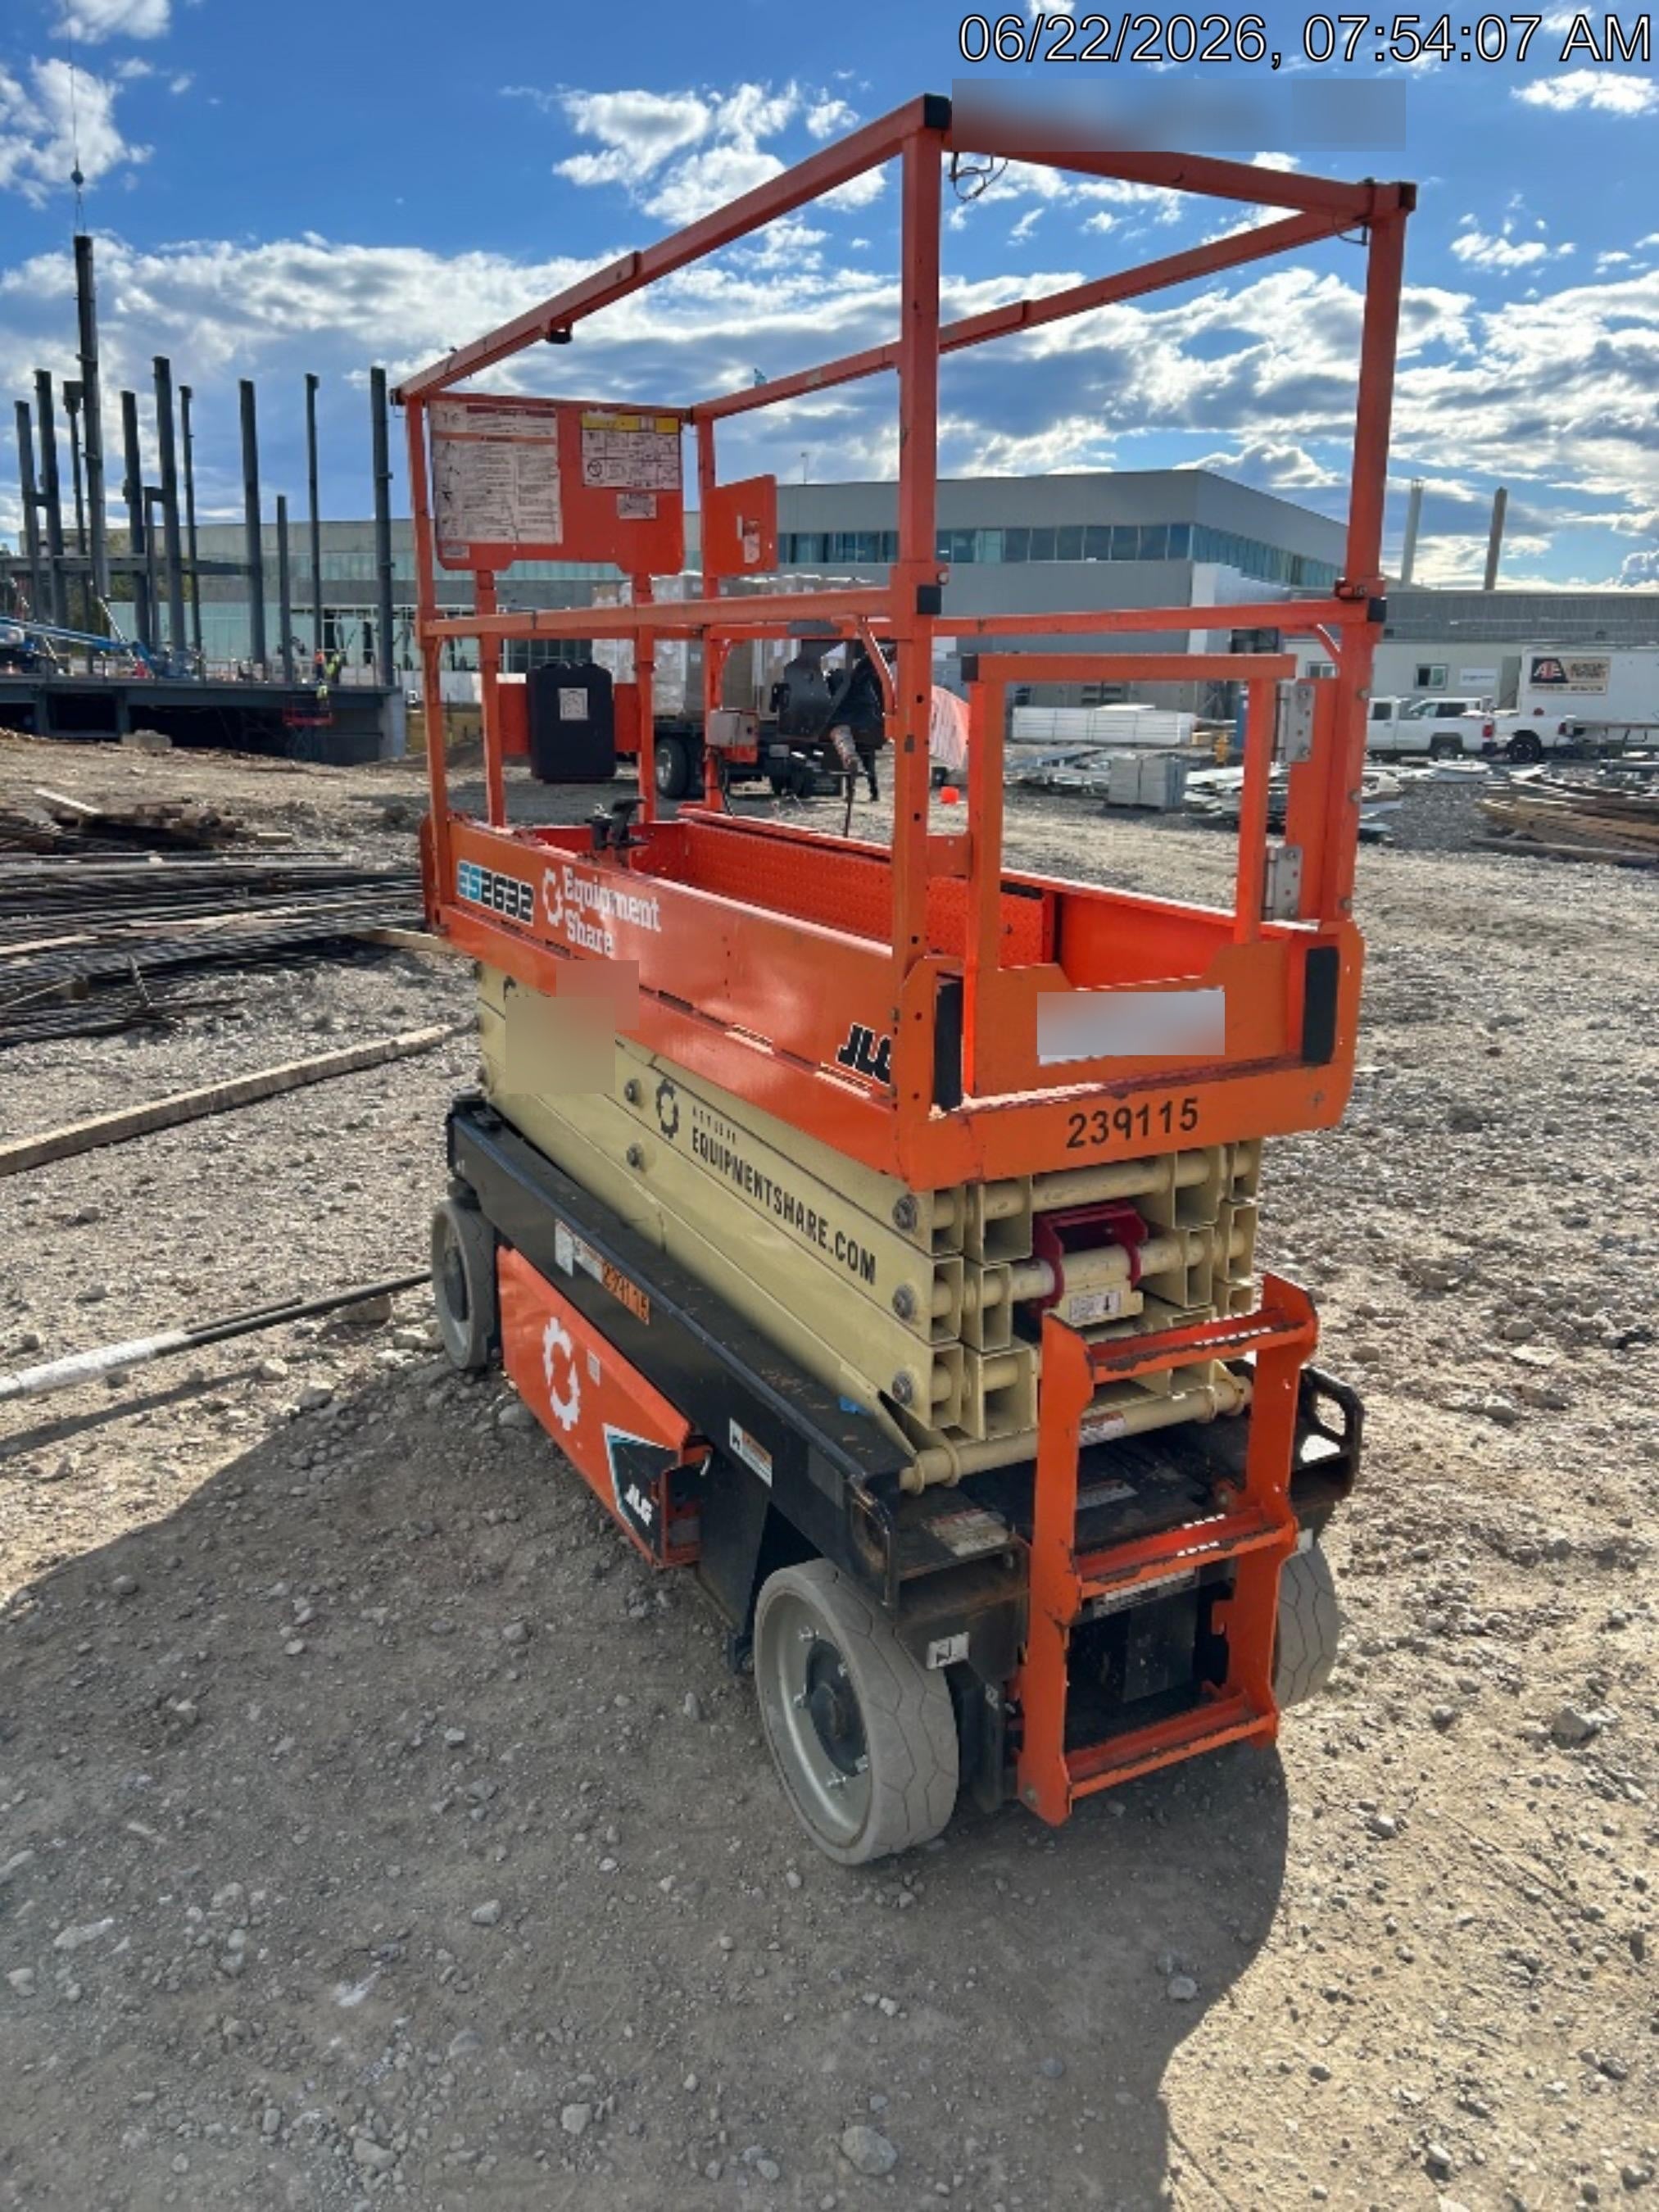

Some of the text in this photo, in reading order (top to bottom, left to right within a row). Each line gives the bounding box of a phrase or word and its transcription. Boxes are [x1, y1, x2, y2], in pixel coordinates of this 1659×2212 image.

[562, 865, 662, 931] Equipment
[564, 909, 614, 959] Share
[1067, 1098, 1198, 1149] 239115
[692, 1125, 876, 1285] EQUIPMENTSHARE.COM
[624, 1483, 654, 1527] JLG
